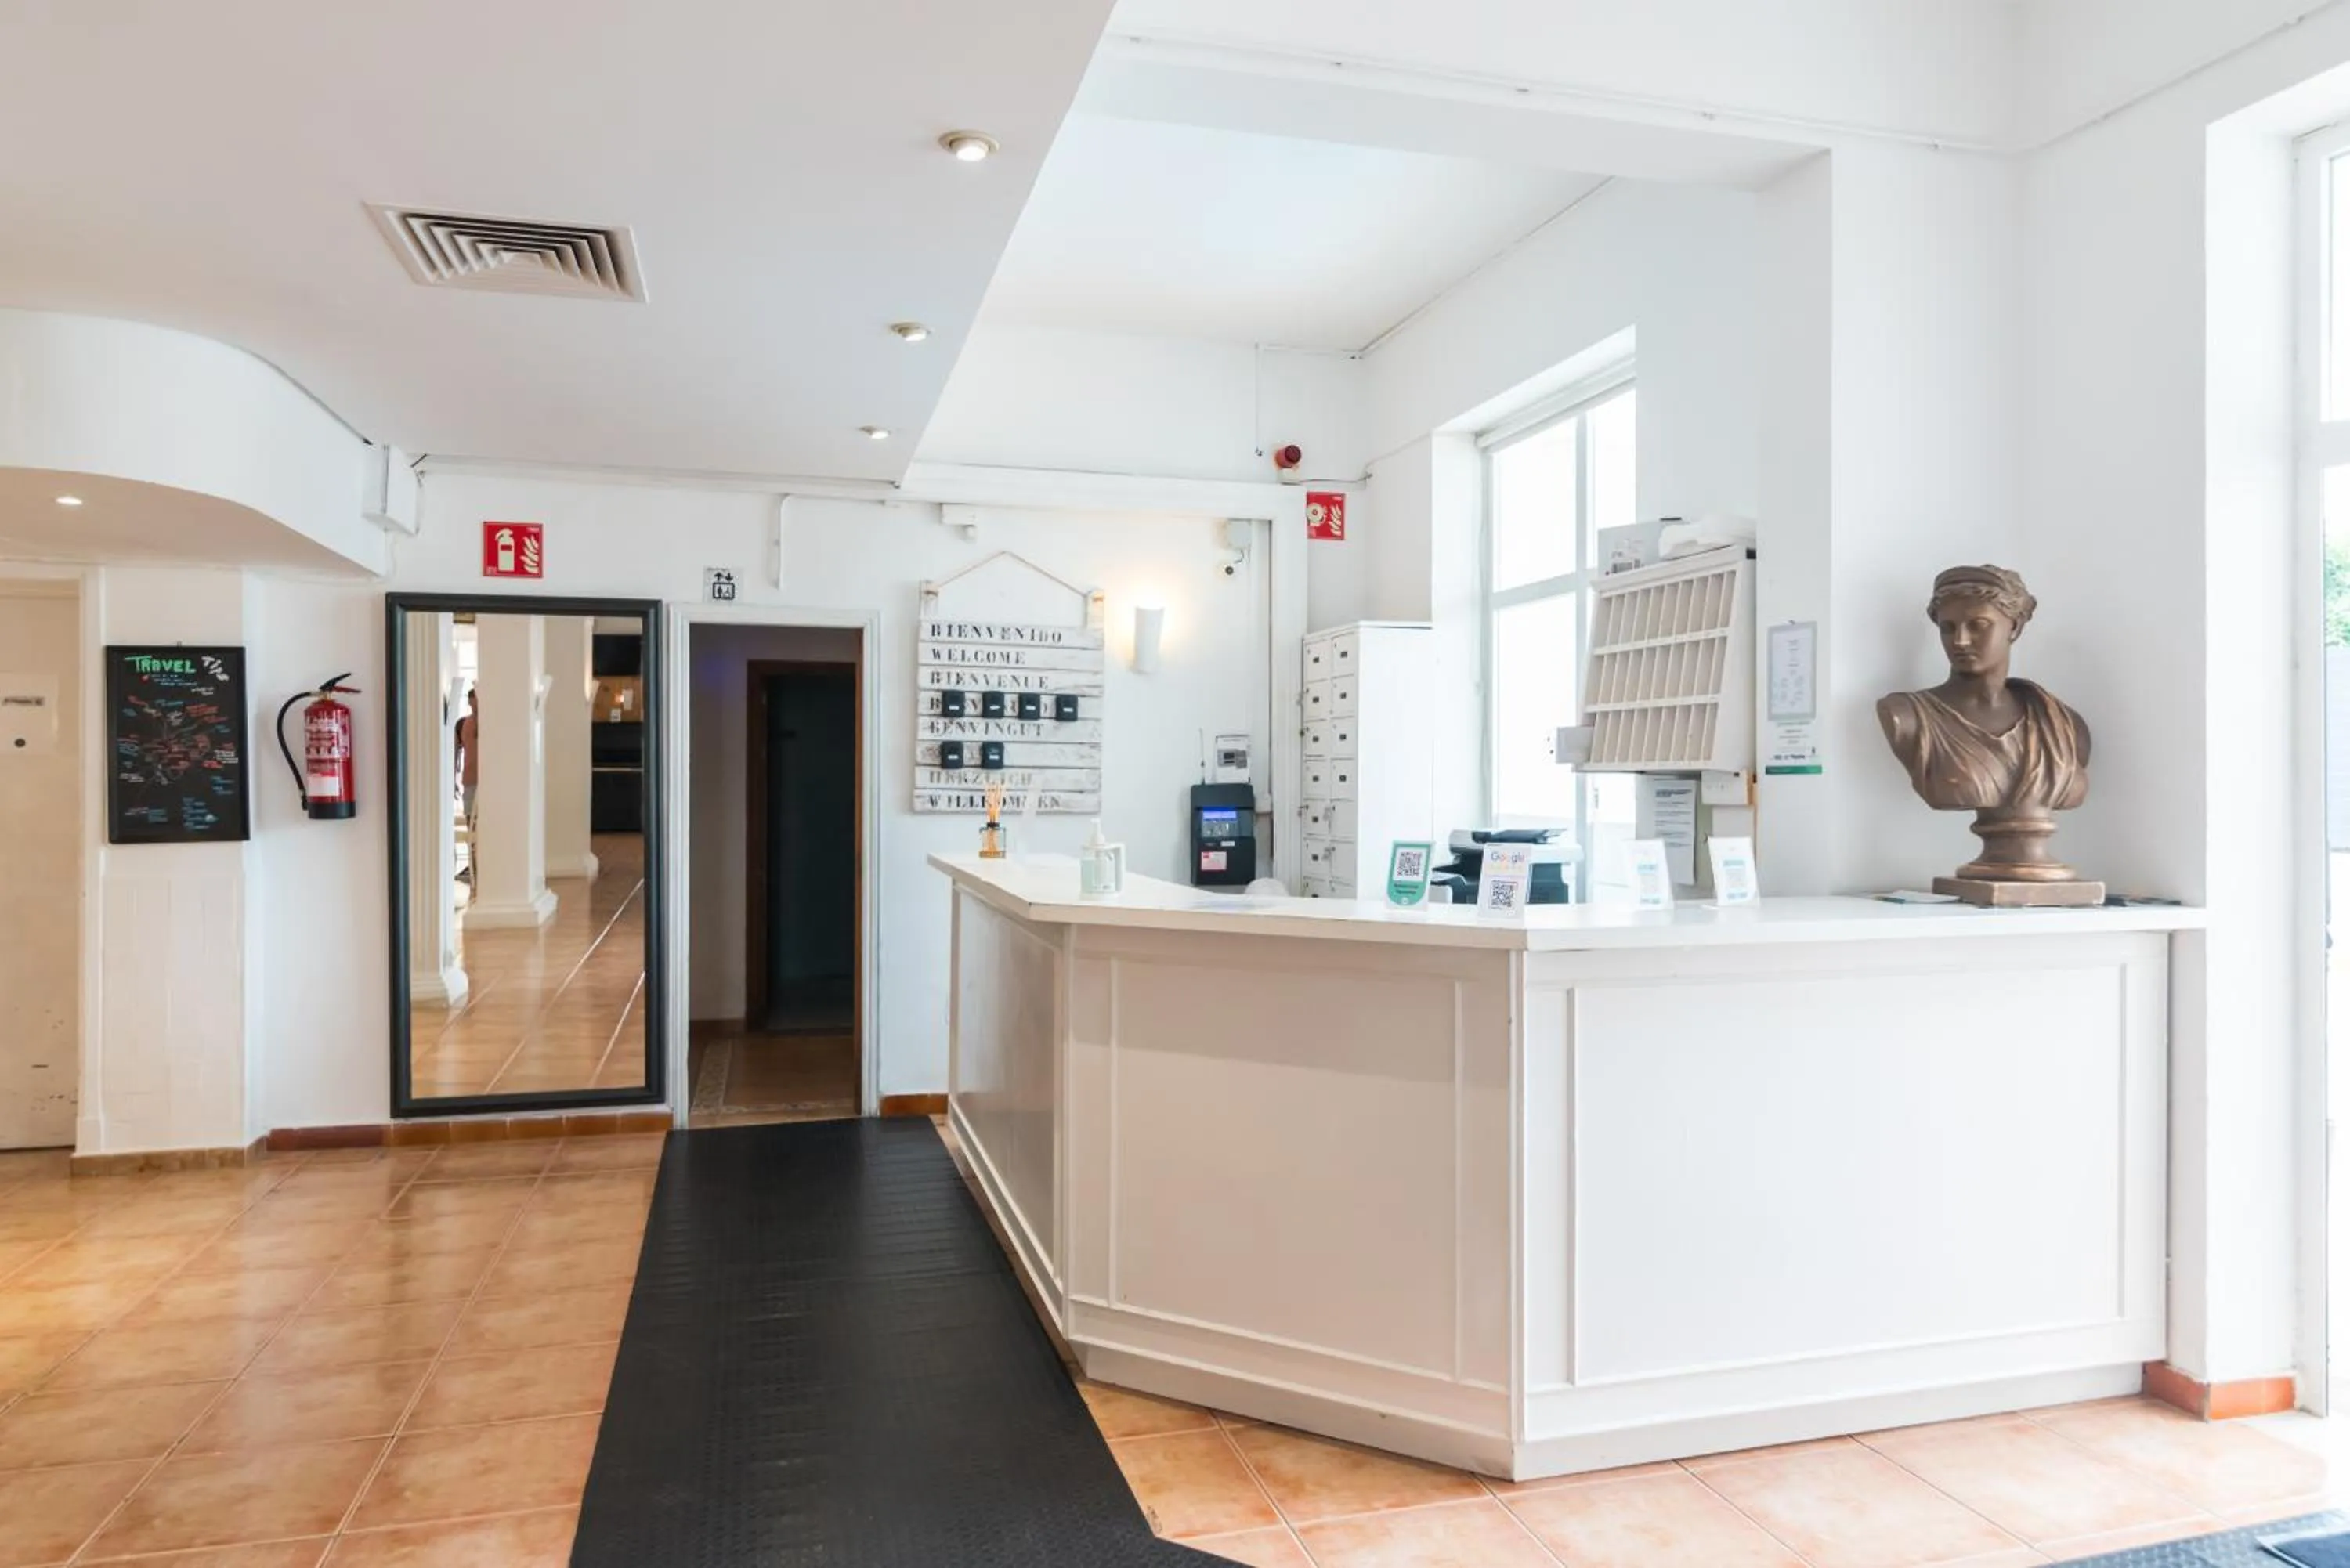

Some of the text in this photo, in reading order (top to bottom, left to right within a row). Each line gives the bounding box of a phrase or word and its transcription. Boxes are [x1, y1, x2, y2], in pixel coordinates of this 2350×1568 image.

[930, 623, 1063, 644] BIENVENIDO
[125, 655, 197, 674] TRAVEL
[931, 648, 1027, 666] WELCOME
[929, 670, 1050, 689] BIENVENUE
[928, 721, 1045, 737] BENVINGUT
